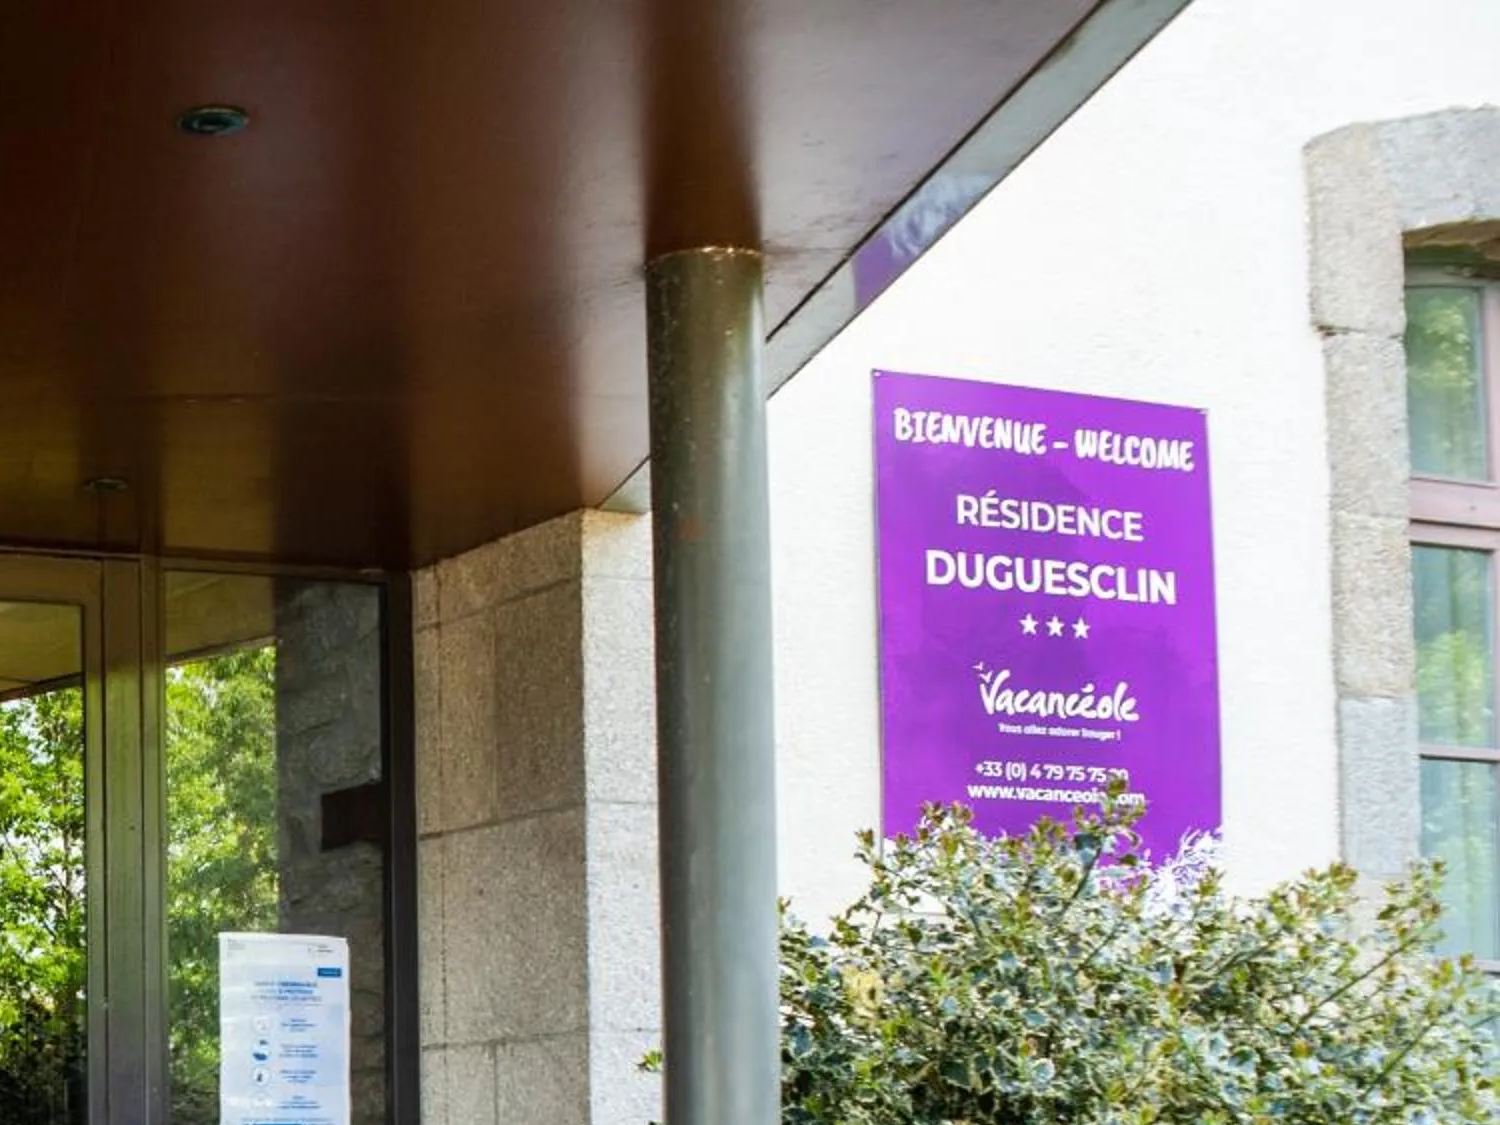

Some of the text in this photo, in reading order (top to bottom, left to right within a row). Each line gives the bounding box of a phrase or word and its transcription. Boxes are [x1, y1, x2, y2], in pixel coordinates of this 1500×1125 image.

[894, 408, 1046, 454] BIENVENUE
[1074, 429, 1194, 471] WELCOME
[956, 491, 1143, 541] RÉSIDENCE
[925, 549, 1176, 604] DUGUESCLIN
[980, 670, 1140, 722] Vacancéole
[975, 760, 1002, 777] +33
[1005, 762, 1027, 782] (0)
[1030, 763, 1041, 779] 4
[1044, 764, 1064, 780] 79
[1066, 765, 1086, 781] 75
[1087, 767, 1107, 783] 75
